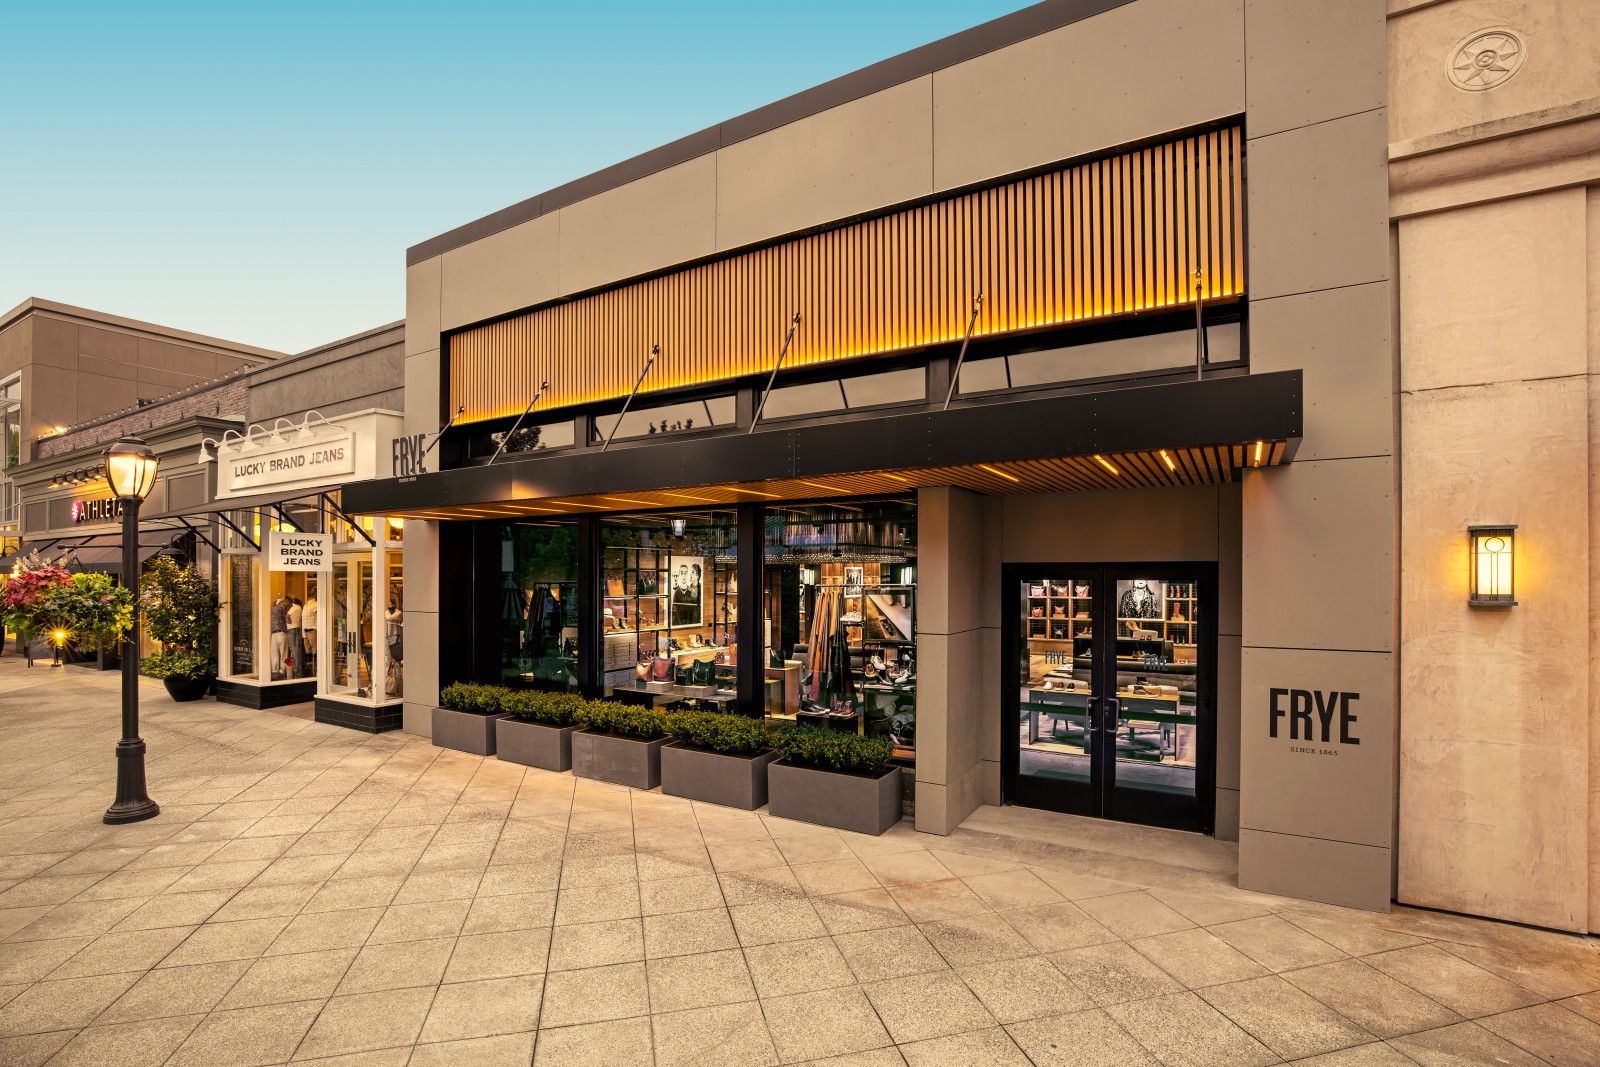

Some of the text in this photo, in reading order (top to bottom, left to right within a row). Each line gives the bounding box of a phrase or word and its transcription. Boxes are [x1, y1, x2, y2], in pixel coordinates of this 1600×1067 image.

[392, 434, 427, 476] FRYE
[234, 448, 344, 478] LUCKY BRAND JEANS
[281, 538, 322, 547] LUCKY
[280, 548, 323, 556] BRAND
[1044, 649, 1066, 664] FRYE
[1143, 655, 1168, 671] FRYE
[1269, 687, 1360, 745] FRYE
[1290, 746, 1316, 755] SINCE
